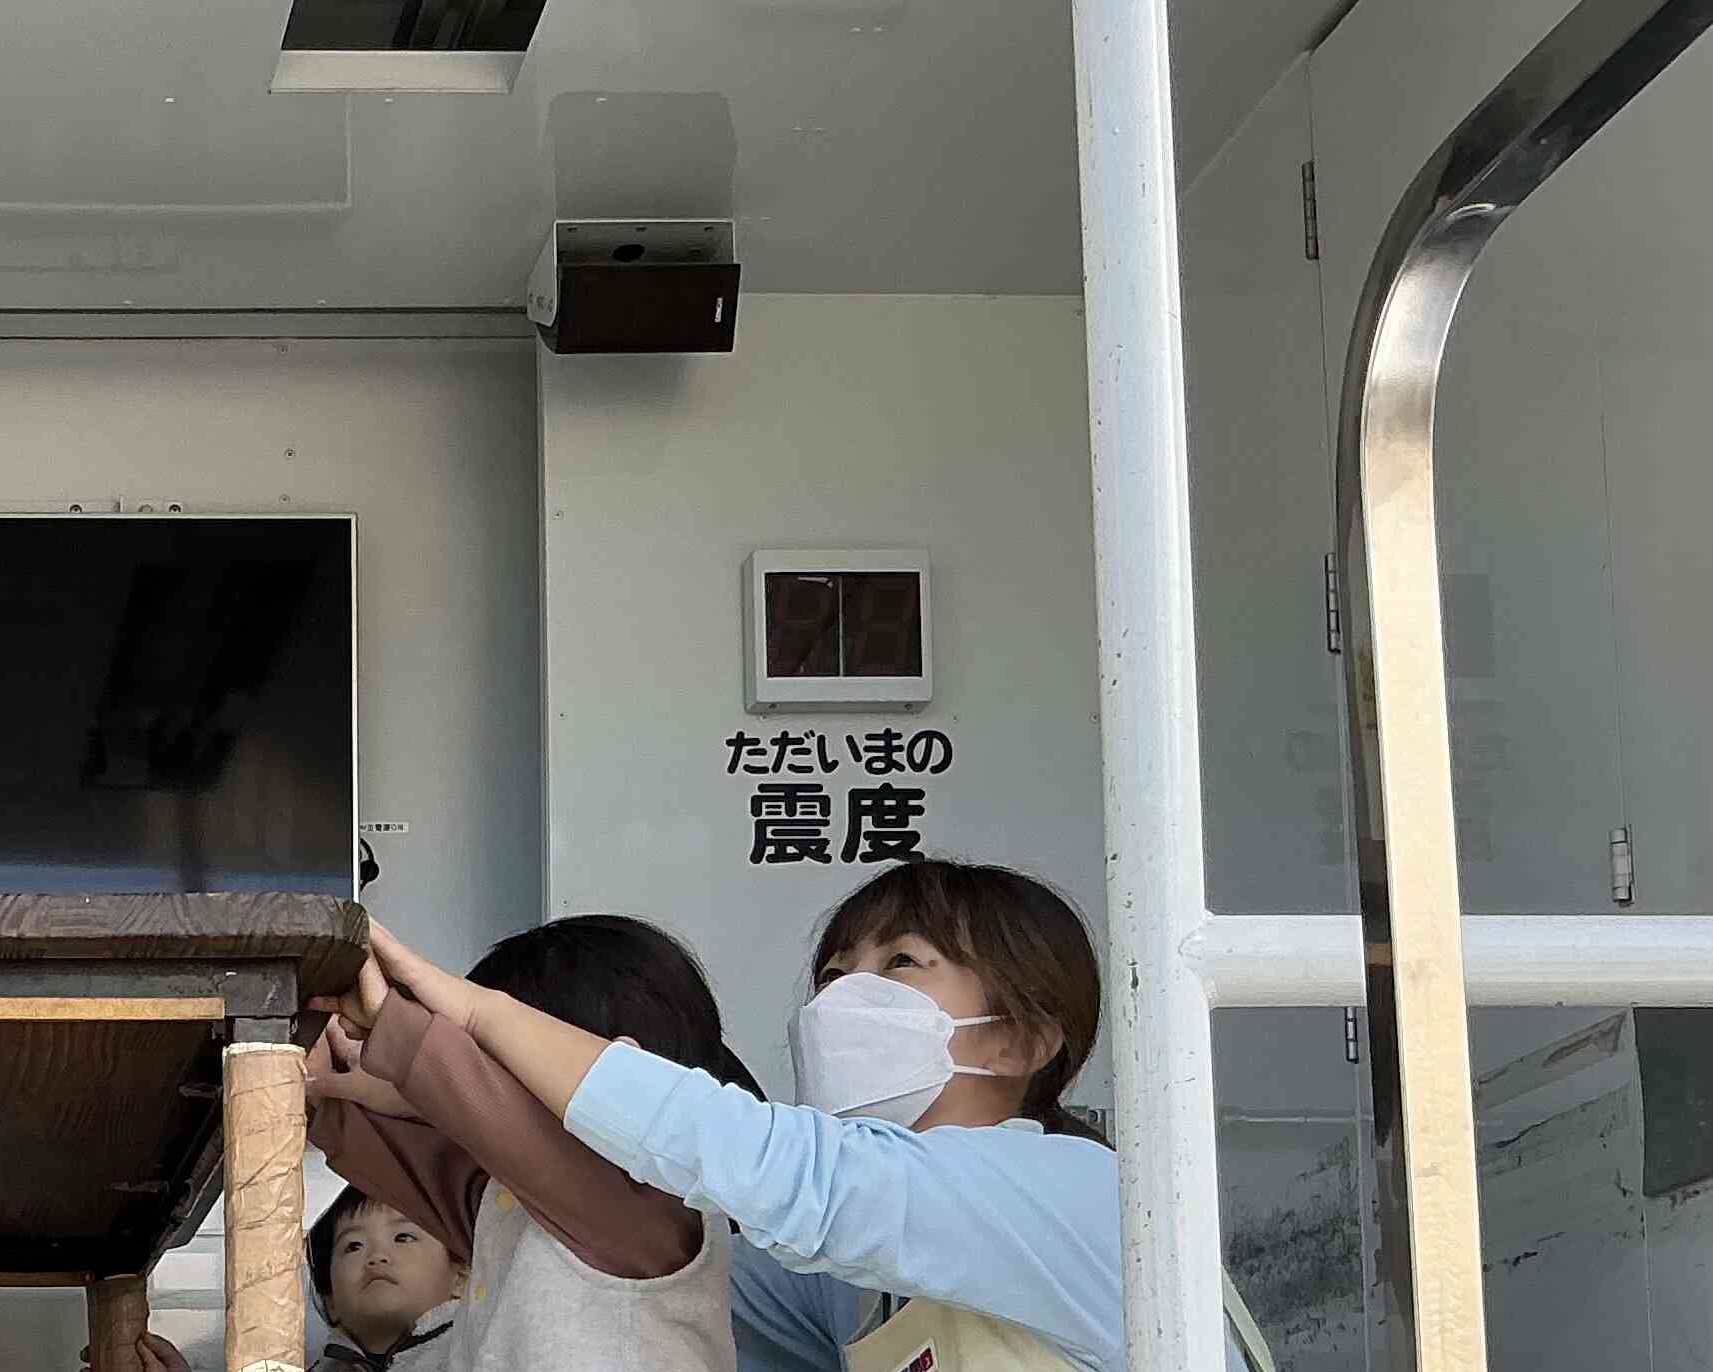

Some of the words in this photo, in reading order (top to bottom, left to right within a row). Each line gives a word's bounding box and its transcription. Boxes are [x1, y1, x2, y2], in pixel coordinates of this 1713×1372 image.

[726, 728, 953, 775] ただいまの
[750, 783, 926, 864] 震度
